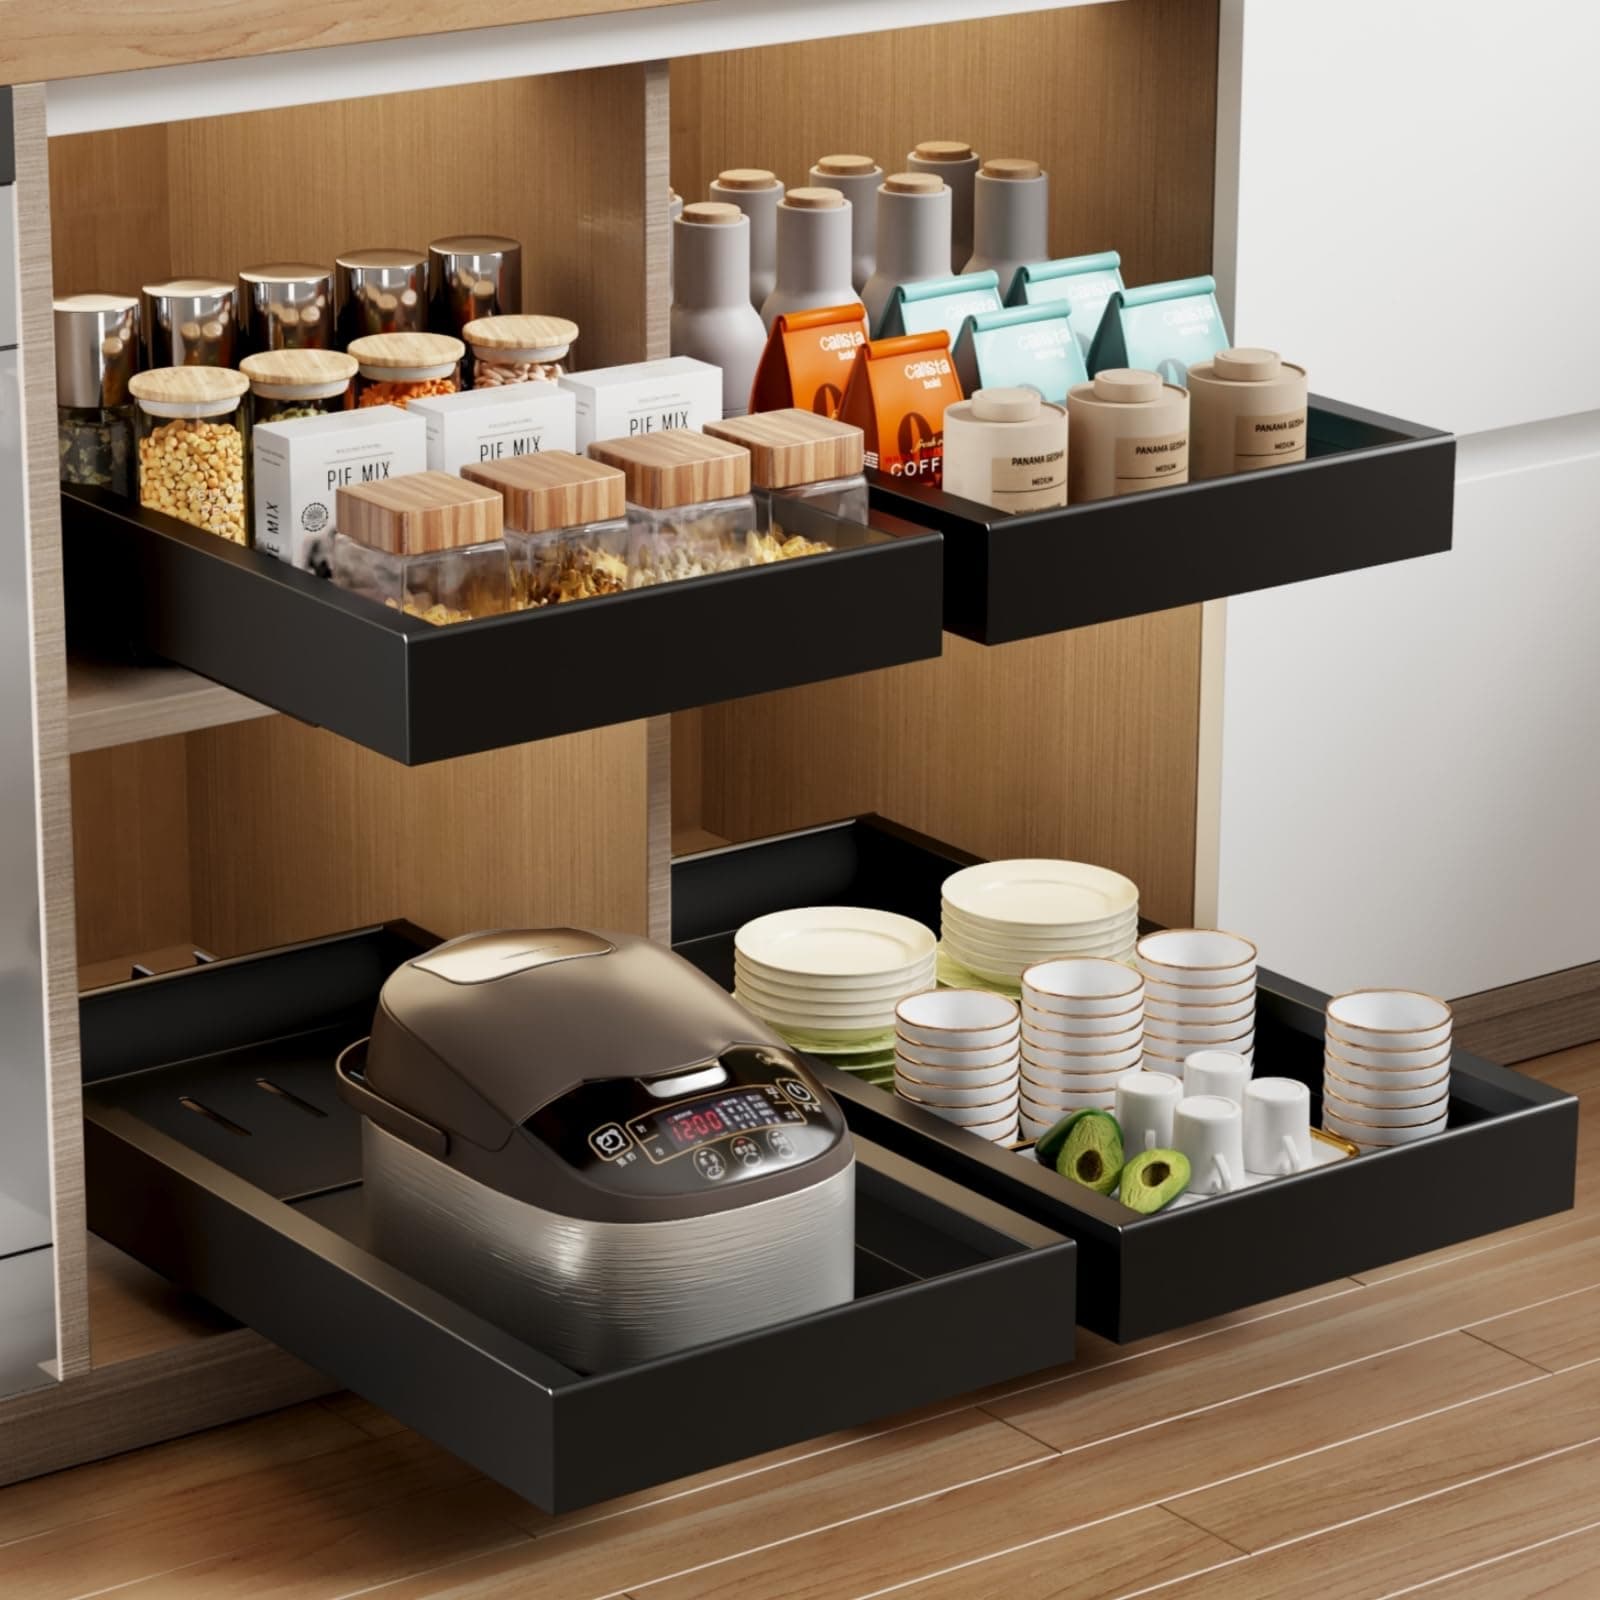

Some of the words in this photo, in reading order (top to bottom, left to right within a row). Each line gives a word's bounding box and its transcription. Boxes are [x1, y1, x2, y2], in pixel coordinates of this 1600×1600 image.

[662, 410, 689, 430] MIX
[1255, 421, 1287, 433] PANAMA
[513, 435, 541, 456] MIX
[1135, 443, 1168, 455] PANAMA
[890, 456, 941, 477] COFF
[1011, 454, 1045, 467] PANAMA
[361, 461, 391, 482] MIX
[266, 501, 281, 535] MIX
